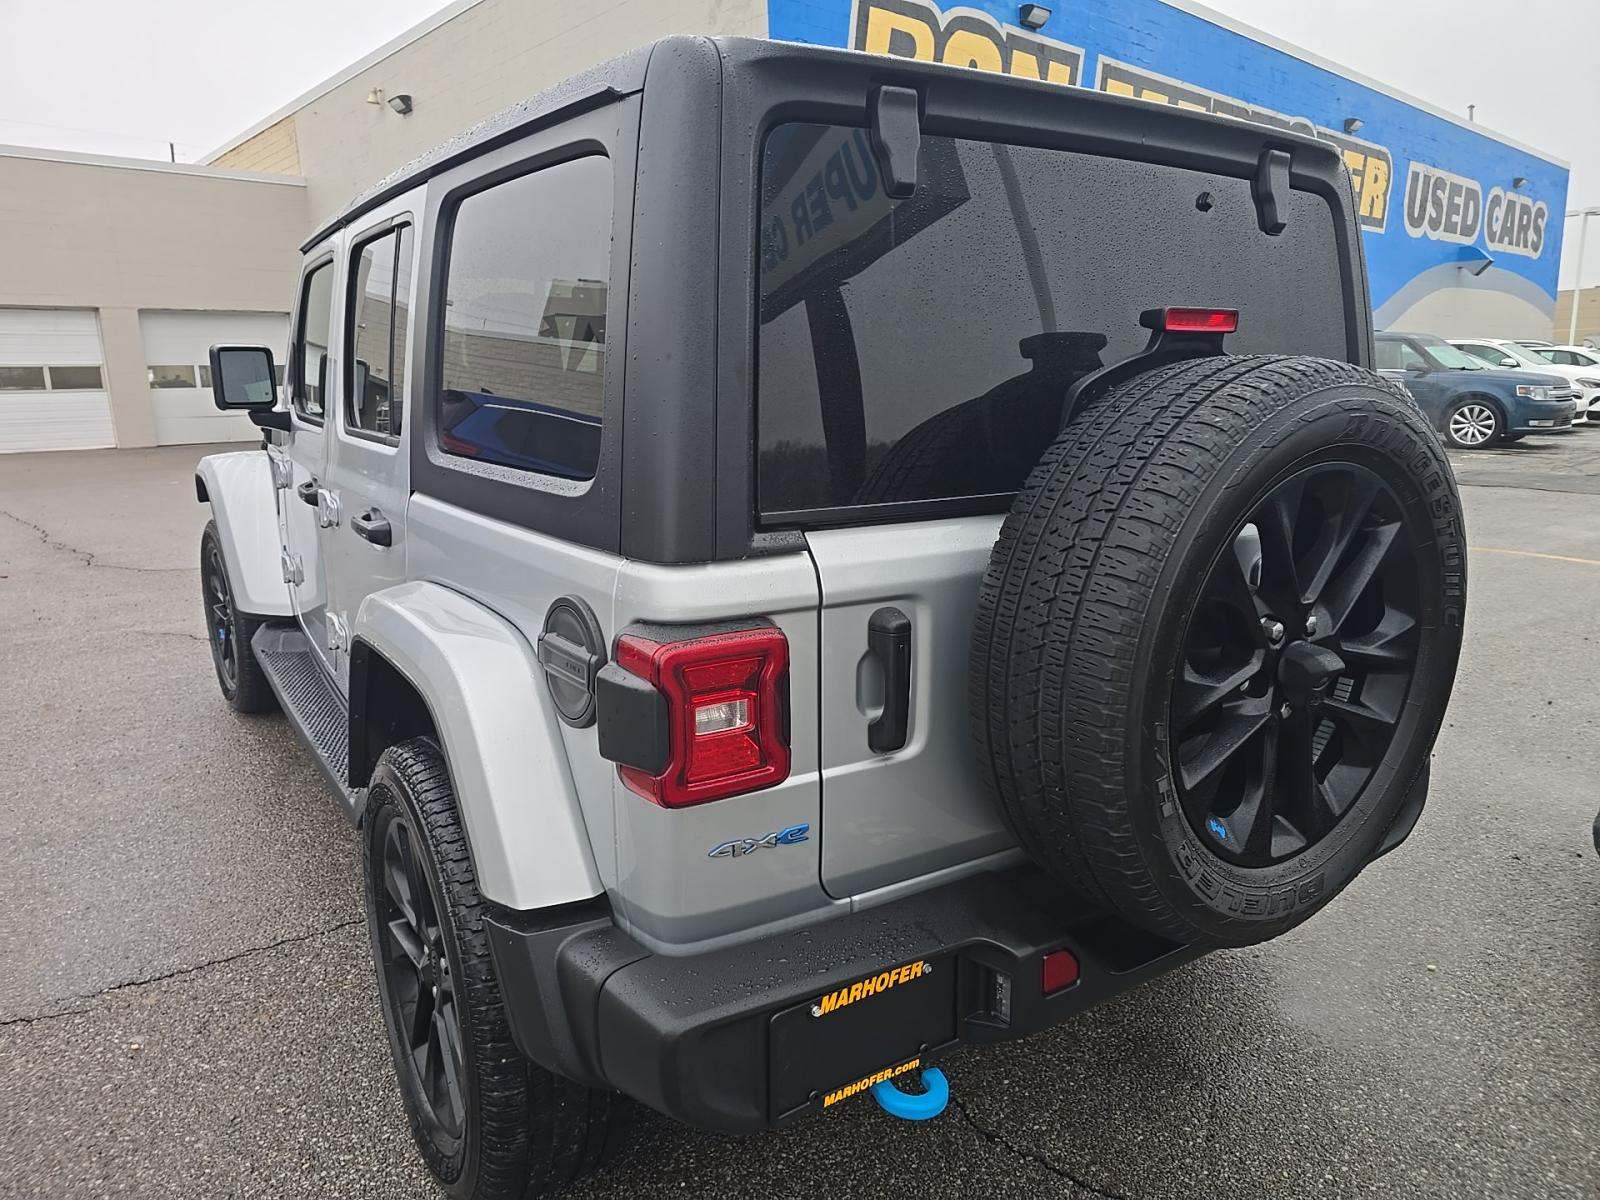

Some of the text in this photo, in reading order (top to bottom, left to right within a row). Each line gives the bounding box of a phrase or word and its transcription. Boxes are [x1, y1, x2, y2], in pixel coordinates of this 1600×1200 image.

[1406, 170, 1547, 254] USED CARS
[820, 961, 924, 1016] MARHOFER
[823, 1058, 920, 1108] MARHOFER.com
